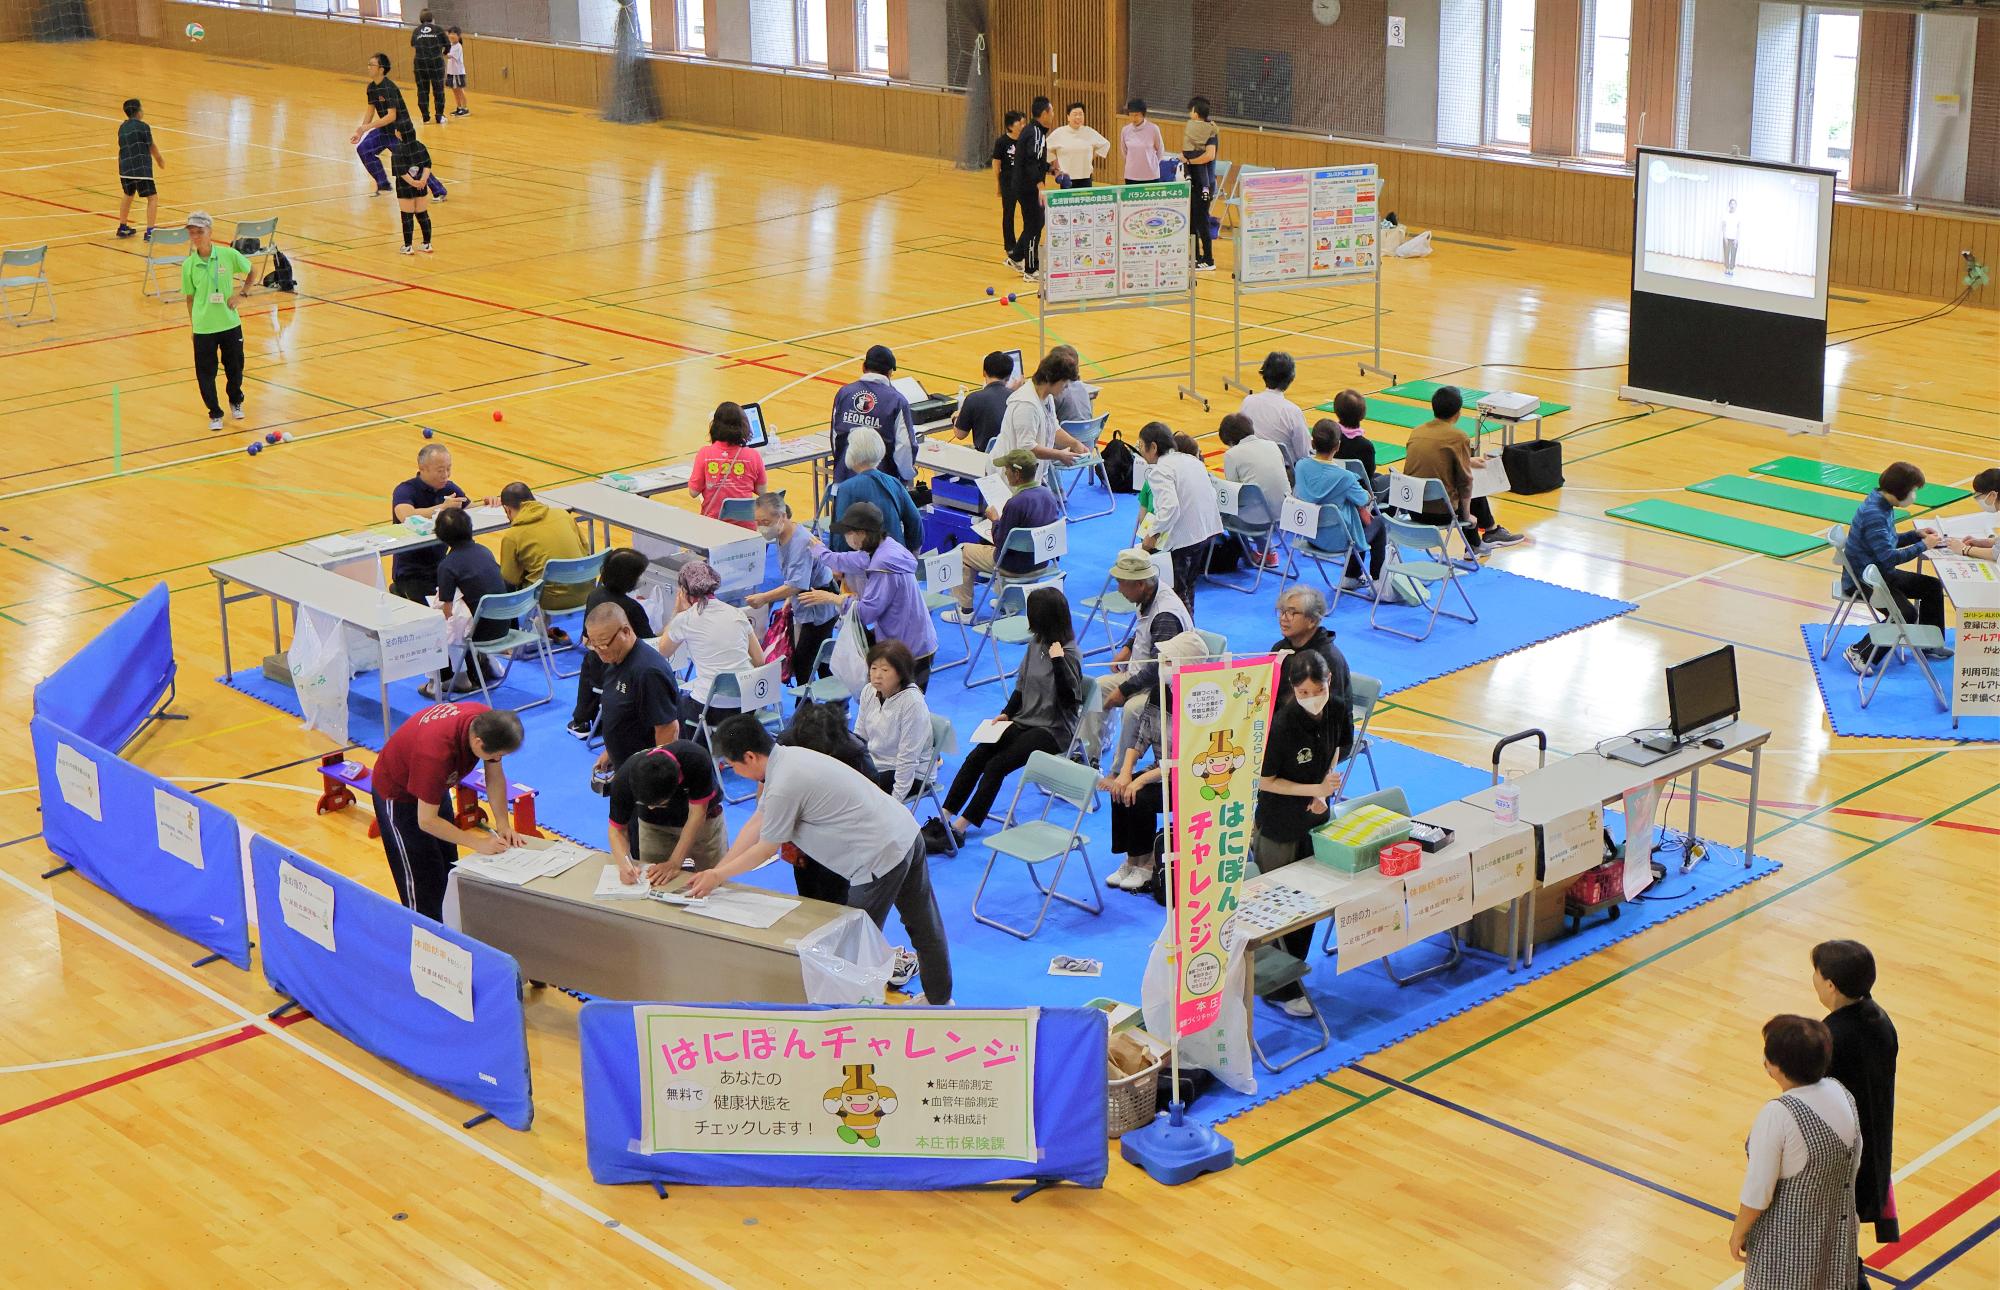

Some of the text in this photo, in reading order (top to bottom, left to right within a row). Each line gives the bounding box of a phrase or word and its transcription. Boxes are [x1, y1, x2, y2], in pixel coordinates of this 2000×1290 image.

[843, 411, 881, 427] GEORGIA
[1961, 667, 2000, 677] 利用可能
[1217, 801, 1246, 912] はにぽん
[1188, 811, 1213, 953] チャレンジ
[661, 1025, 1020, 1075] はにぽんチャレンジ
[720, 1070, 782, 1086] あなたの
[666, 1088, 703, 1101] 無料で
[713, 1094, 791, 1111] 健康状態を
[915, 1136, 1006, 1150] 本庄市保険課
